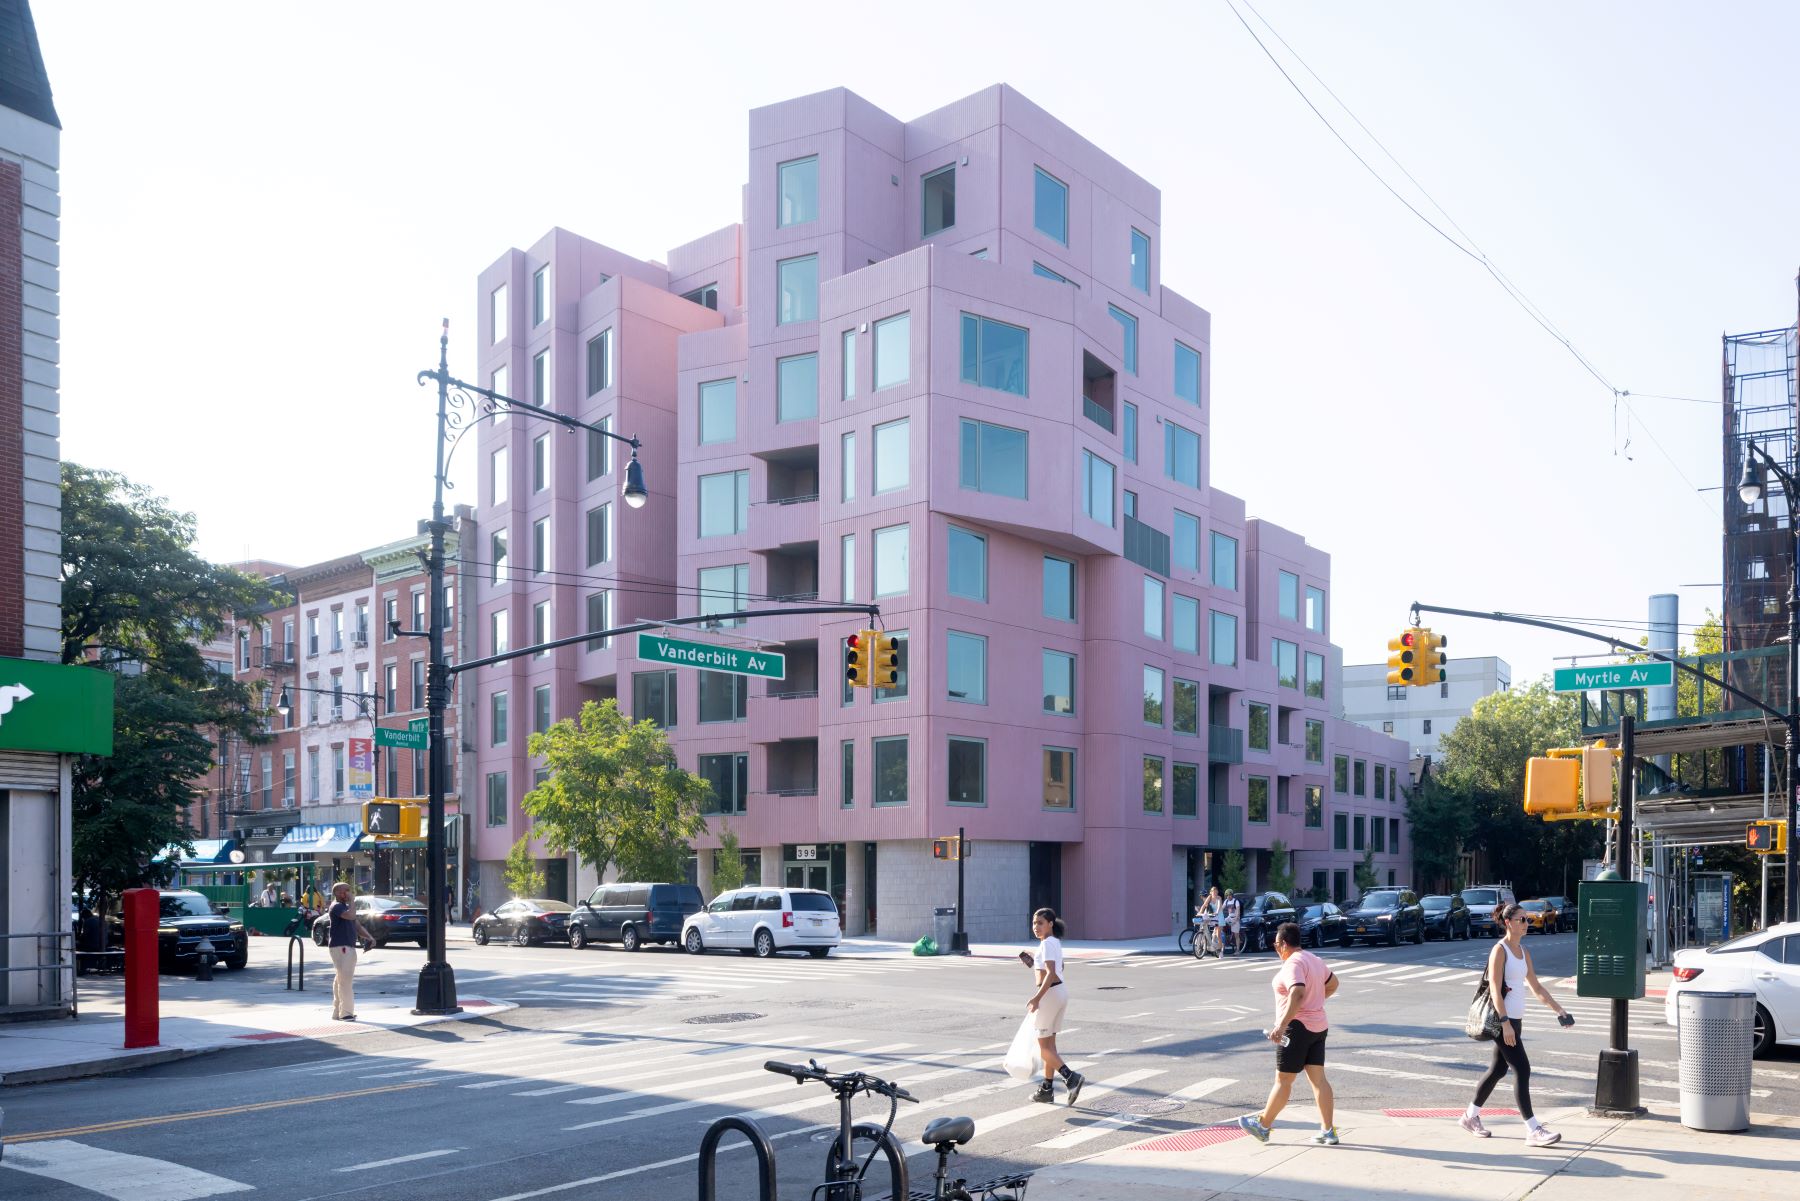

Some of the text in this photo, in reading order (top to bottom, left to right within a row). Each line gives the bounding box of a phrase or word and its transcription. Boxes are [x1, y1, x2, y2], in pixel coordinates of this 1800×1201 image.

[657, 642, 767, 671] Vanderbilt Av
[1575, 669, 1648, 687] Myrtle Av
[384, 730, 420, 743] Vanderbilt
[354, 741, 366, 790] MYRTLE
[797, 849, 816, 858] 399
